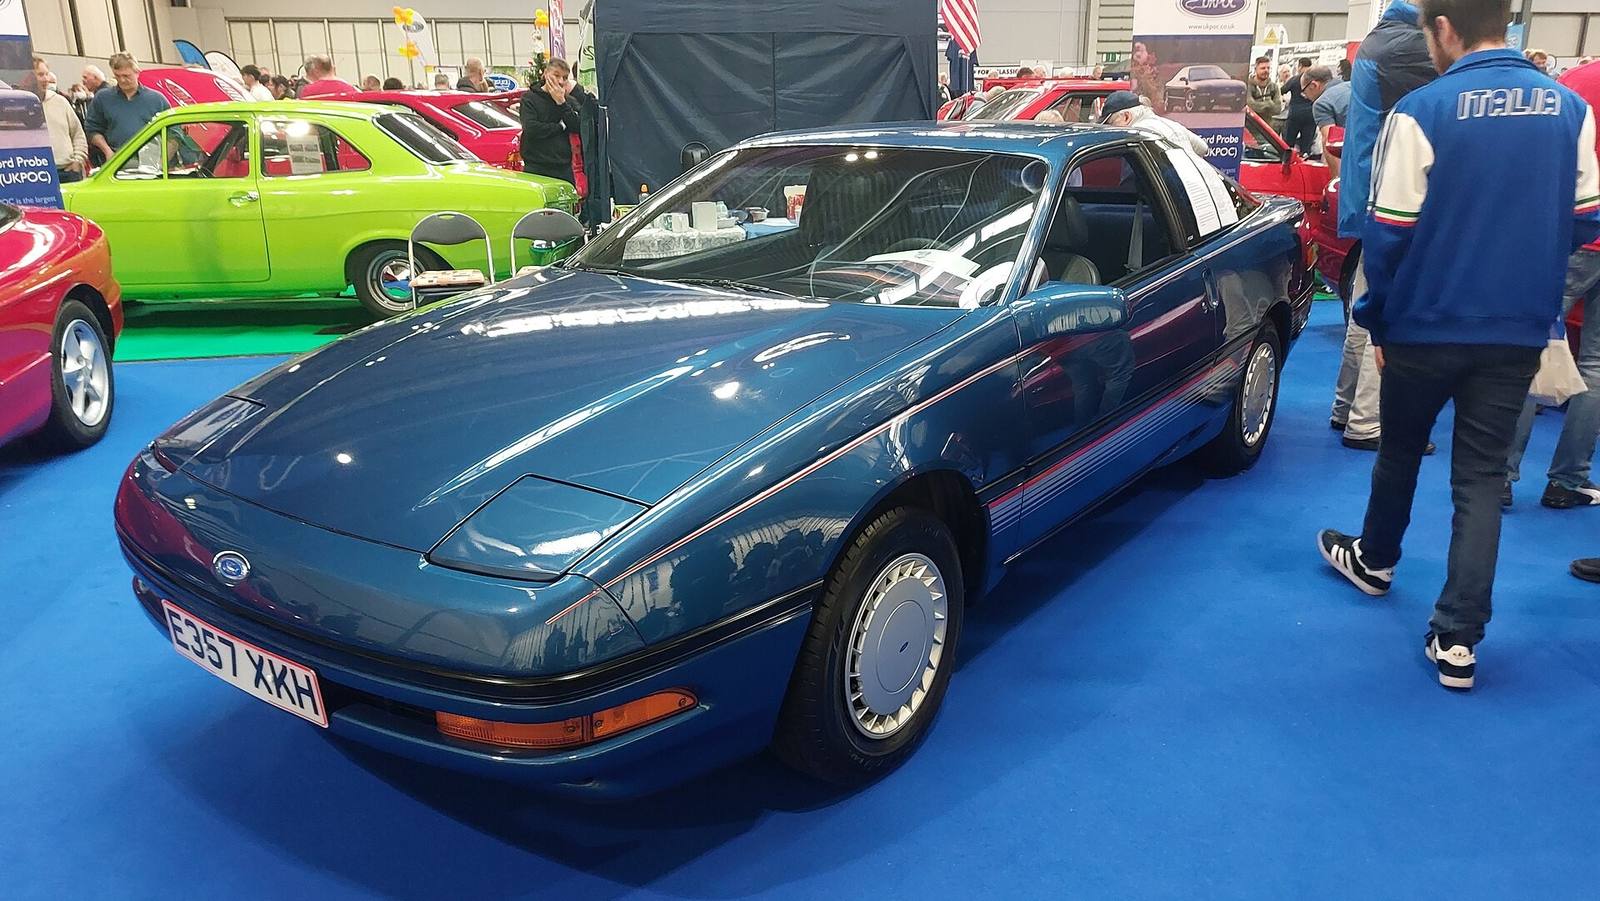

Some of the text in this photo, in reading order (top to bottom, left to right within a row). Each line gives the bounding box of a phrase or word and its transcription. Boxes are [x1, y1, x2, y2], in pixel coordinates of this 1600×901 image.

[1456, 87, 1563, 121] ITALIA
[1216, 134, 1239, 144] Probe
[16, 155, 49, 168] Probe
[0, 170, 52, 187] (UKPOC)
[167, 609, 319, 716] E357 XKH
